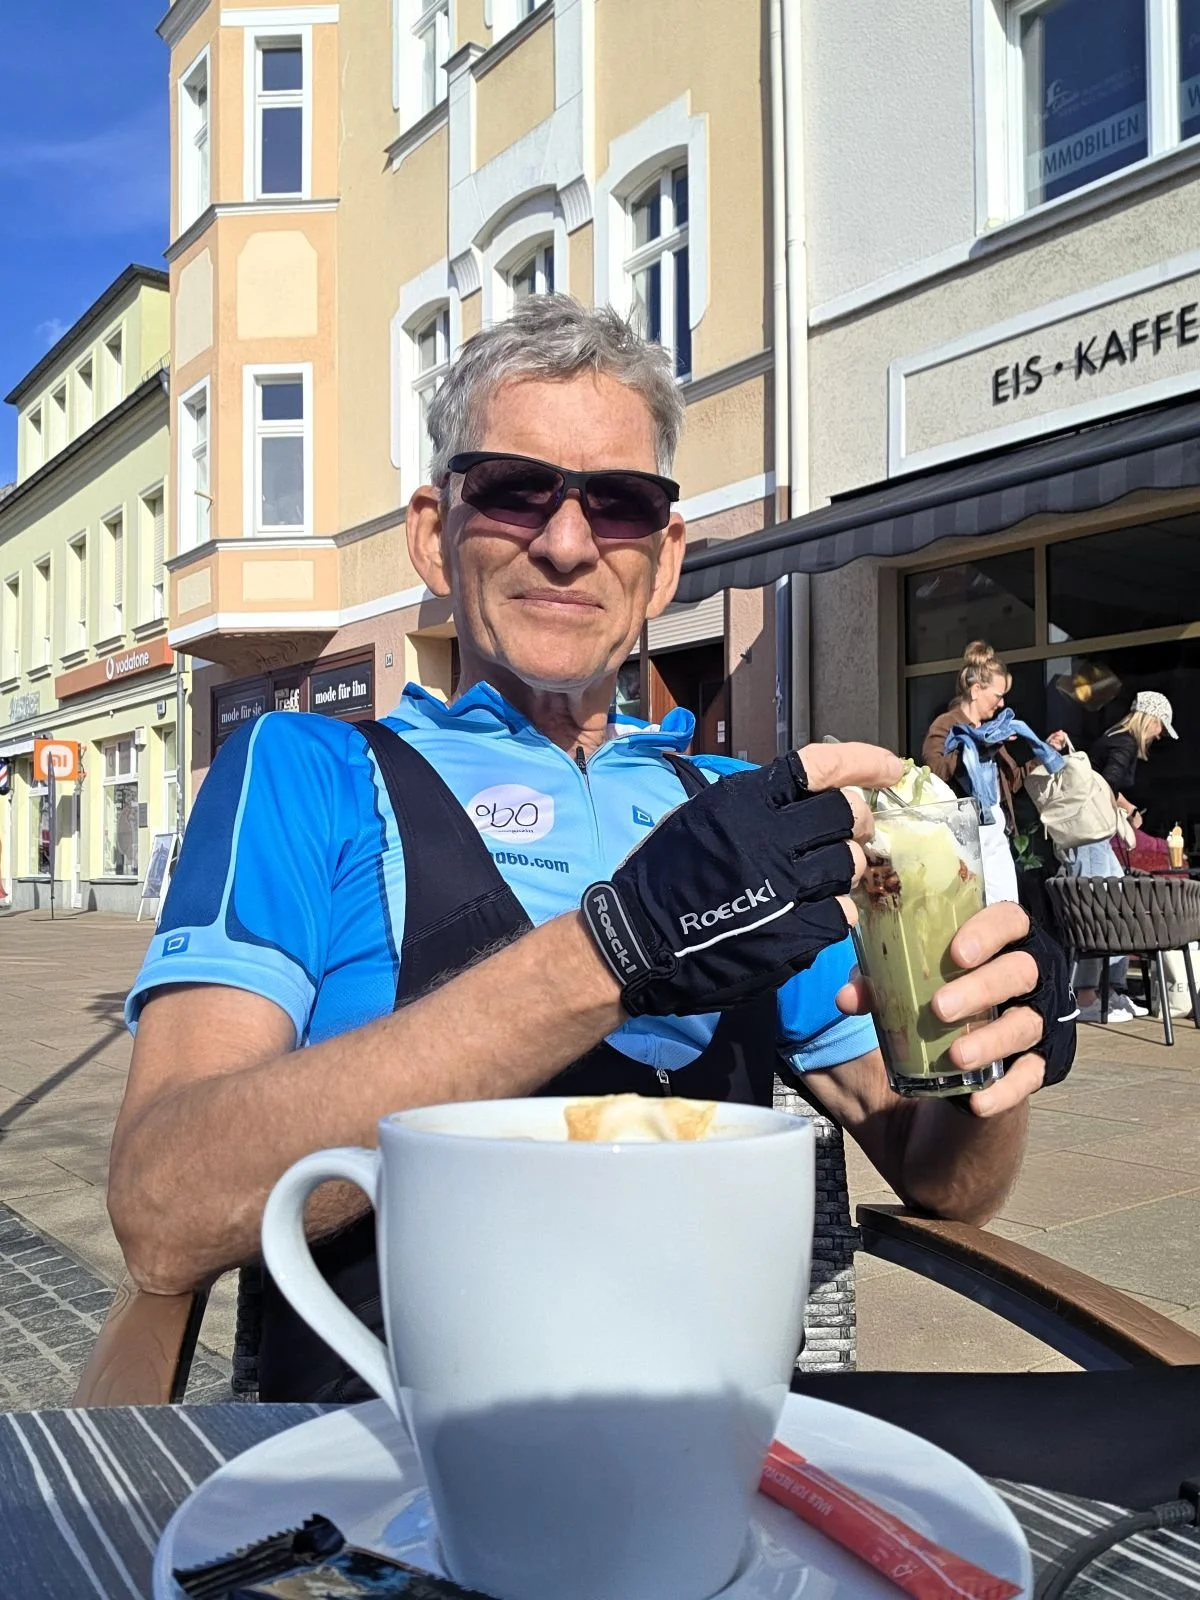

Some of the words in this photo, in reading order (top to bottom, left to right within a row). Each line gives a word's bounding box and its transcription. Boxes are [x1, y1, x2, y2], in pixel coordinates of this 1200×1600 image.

[993, 356, 1042, 405] EIS
[1075, 302, 1200, 380] KAFFE
[115, 651, 149, 674] vodafone
[315, 686, 336, 704] mode
[338, 683, 351, 700] für
[352, 680, 367, 697] ihn
[221, 707, 239, 724] mode
[240, 705, 251, 720] für
[252, 702, 262, 716] sie
